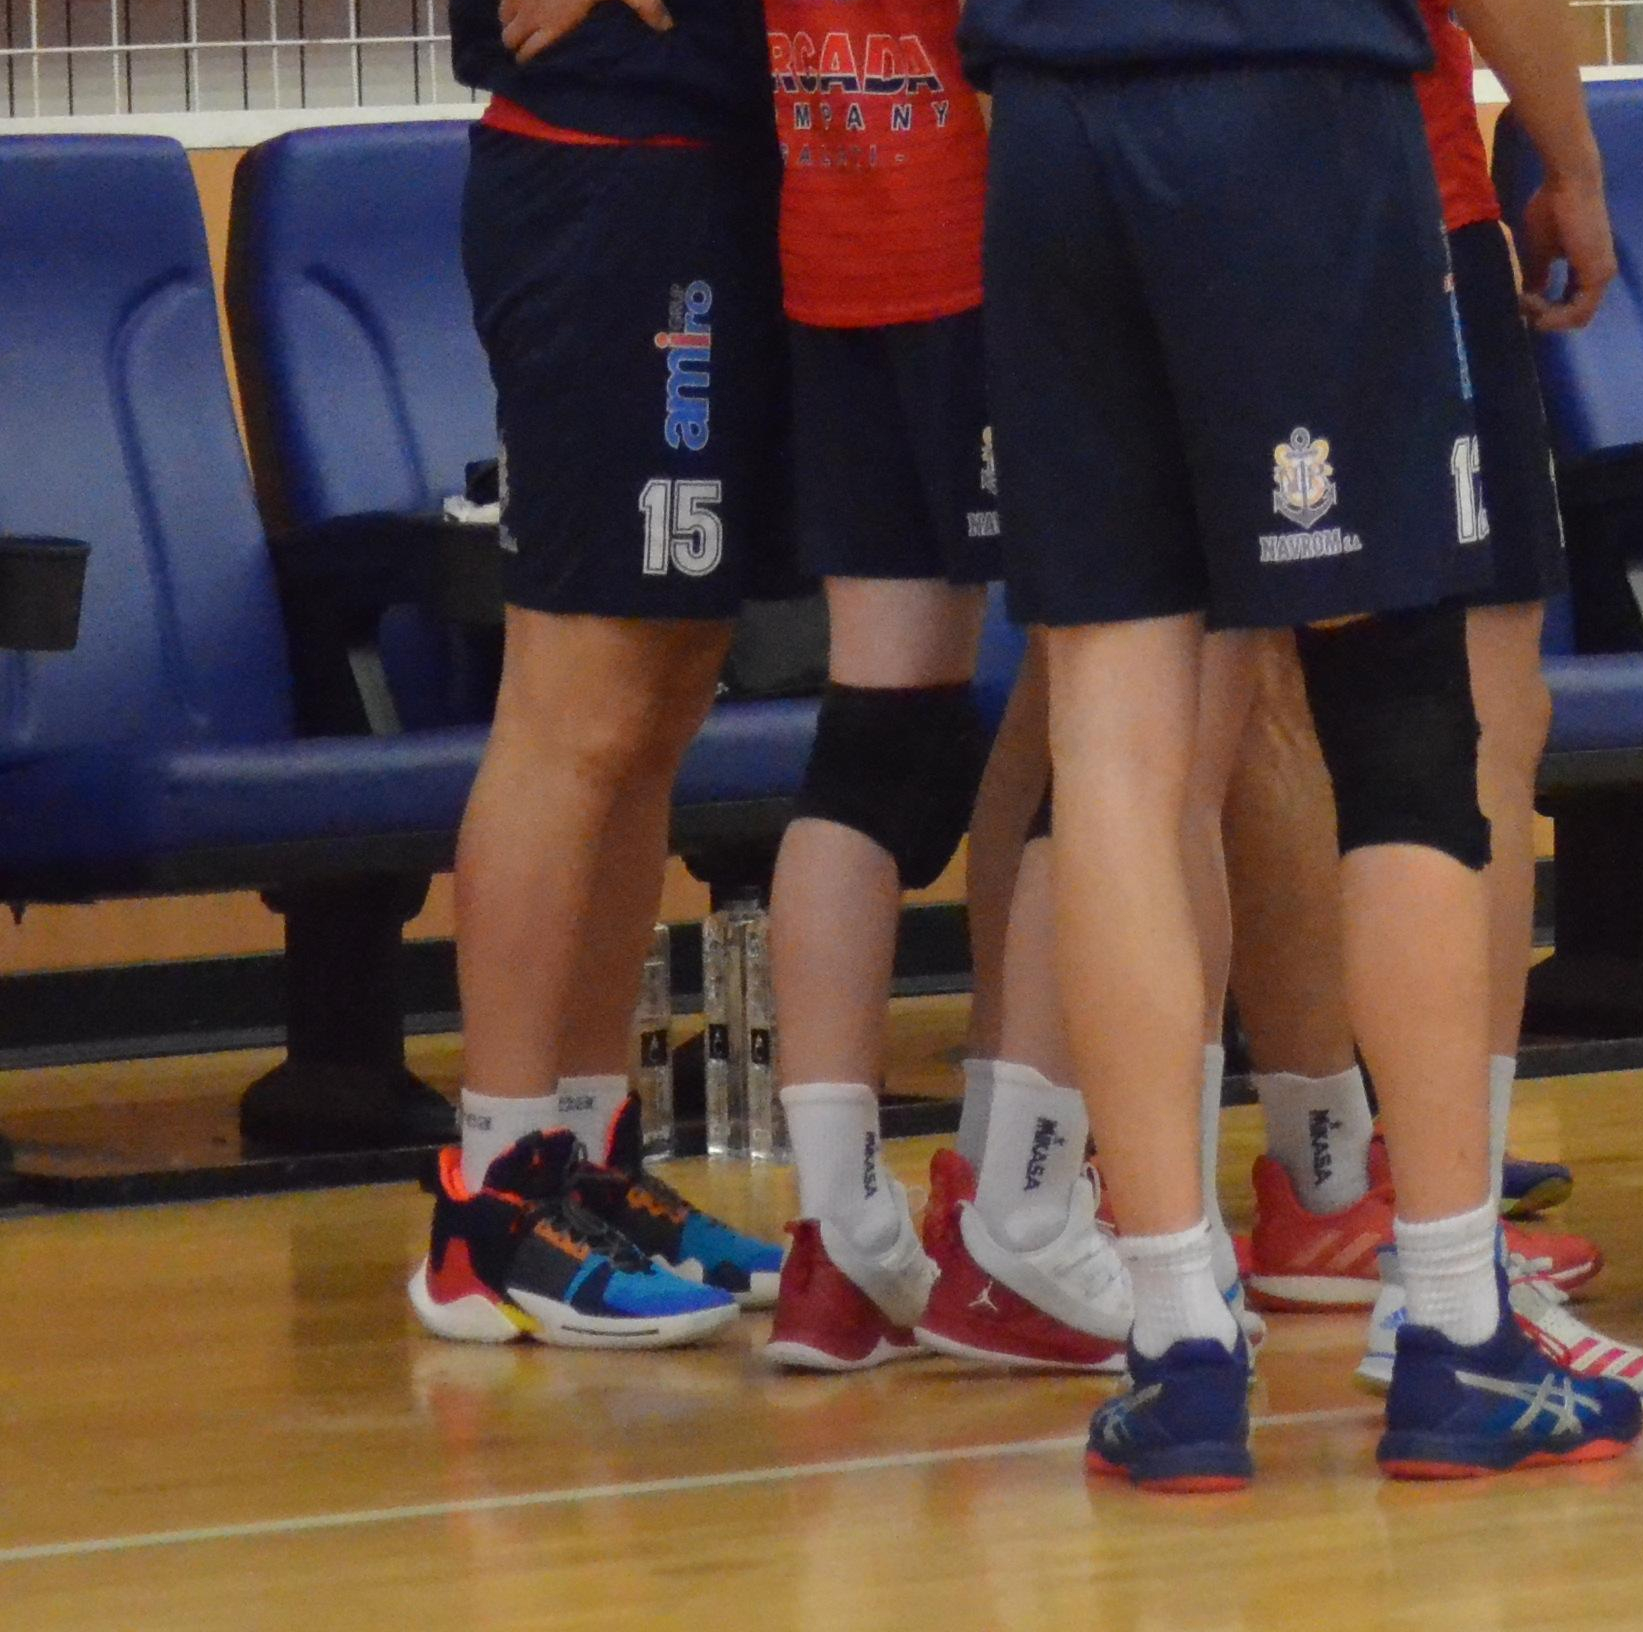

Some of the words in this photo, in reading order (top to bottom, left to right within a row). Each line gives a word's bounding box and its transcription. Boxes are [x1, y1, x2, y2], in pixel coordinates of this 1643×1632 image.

[767, 31, 945, 96] RCADA
[655, 280, 713, 451] amiro
[638, 479, 724, 576] 15
